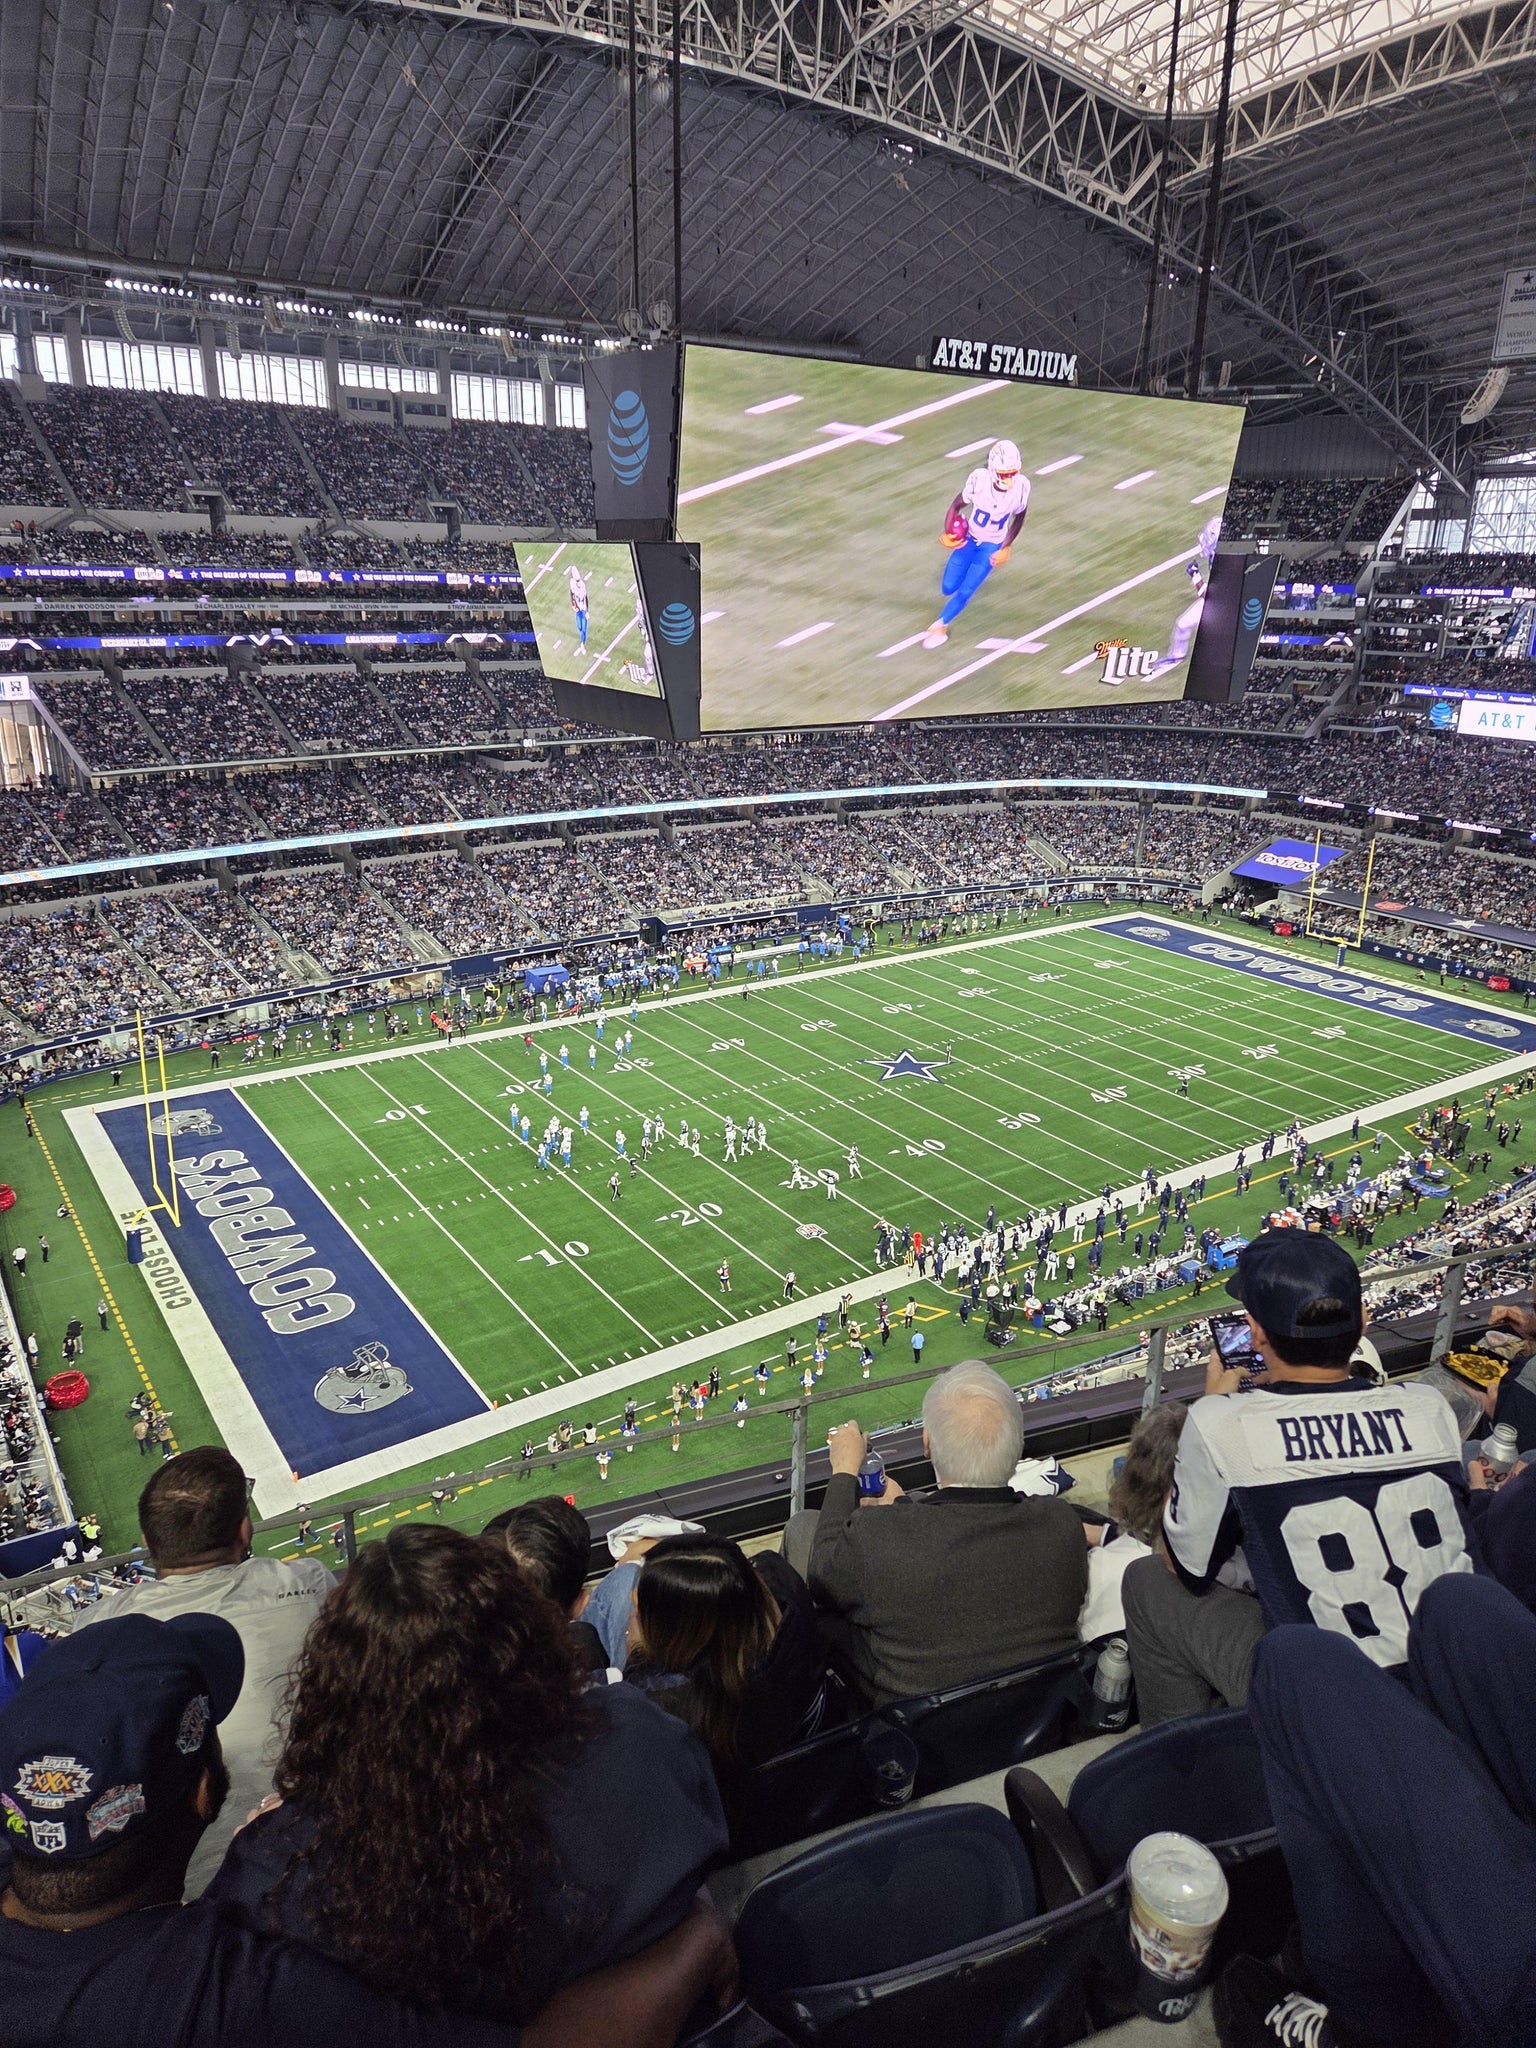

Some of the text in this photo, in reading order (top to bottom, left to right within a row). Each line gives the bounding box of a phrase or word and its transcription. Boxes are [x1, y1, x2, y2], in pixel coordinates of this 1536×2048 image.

[932, 337, 1078, 381] AT&T STADIUM
[1094, 638, 1159, 685] Miller Lite
[1478, 712, 1525, 729] AT&T
[1188, 942, 1435, 1011] COWBOYS
[1311, 1026, 1347, 1039] 10
[711, 1038, 745, 1051] 40
[1241, 1045, 1279, 1060] 20
[613, 1058, 655, 1072] 30
[1167, 1065, 1207, 1081] 30
[1090, 1086, 1128, 1104] 40
[385, 1104, 432, 1121] 10
[996, 1112, 1042, 1130] 50
[905, 1139, 946, 1157] 40
[670, 1202, 723, 1227] 20
[169, 1150, 355, 1334] COWBOYS
[534, 1240, 590, 1267] 10
[141, 1246, 192, 1310] CHOOSE
[1277, 1409, 1413, 1463] BRYANT
[1280, 1472, 1474, 1668] 88
[32, 1771, 74, 1793] XXX
